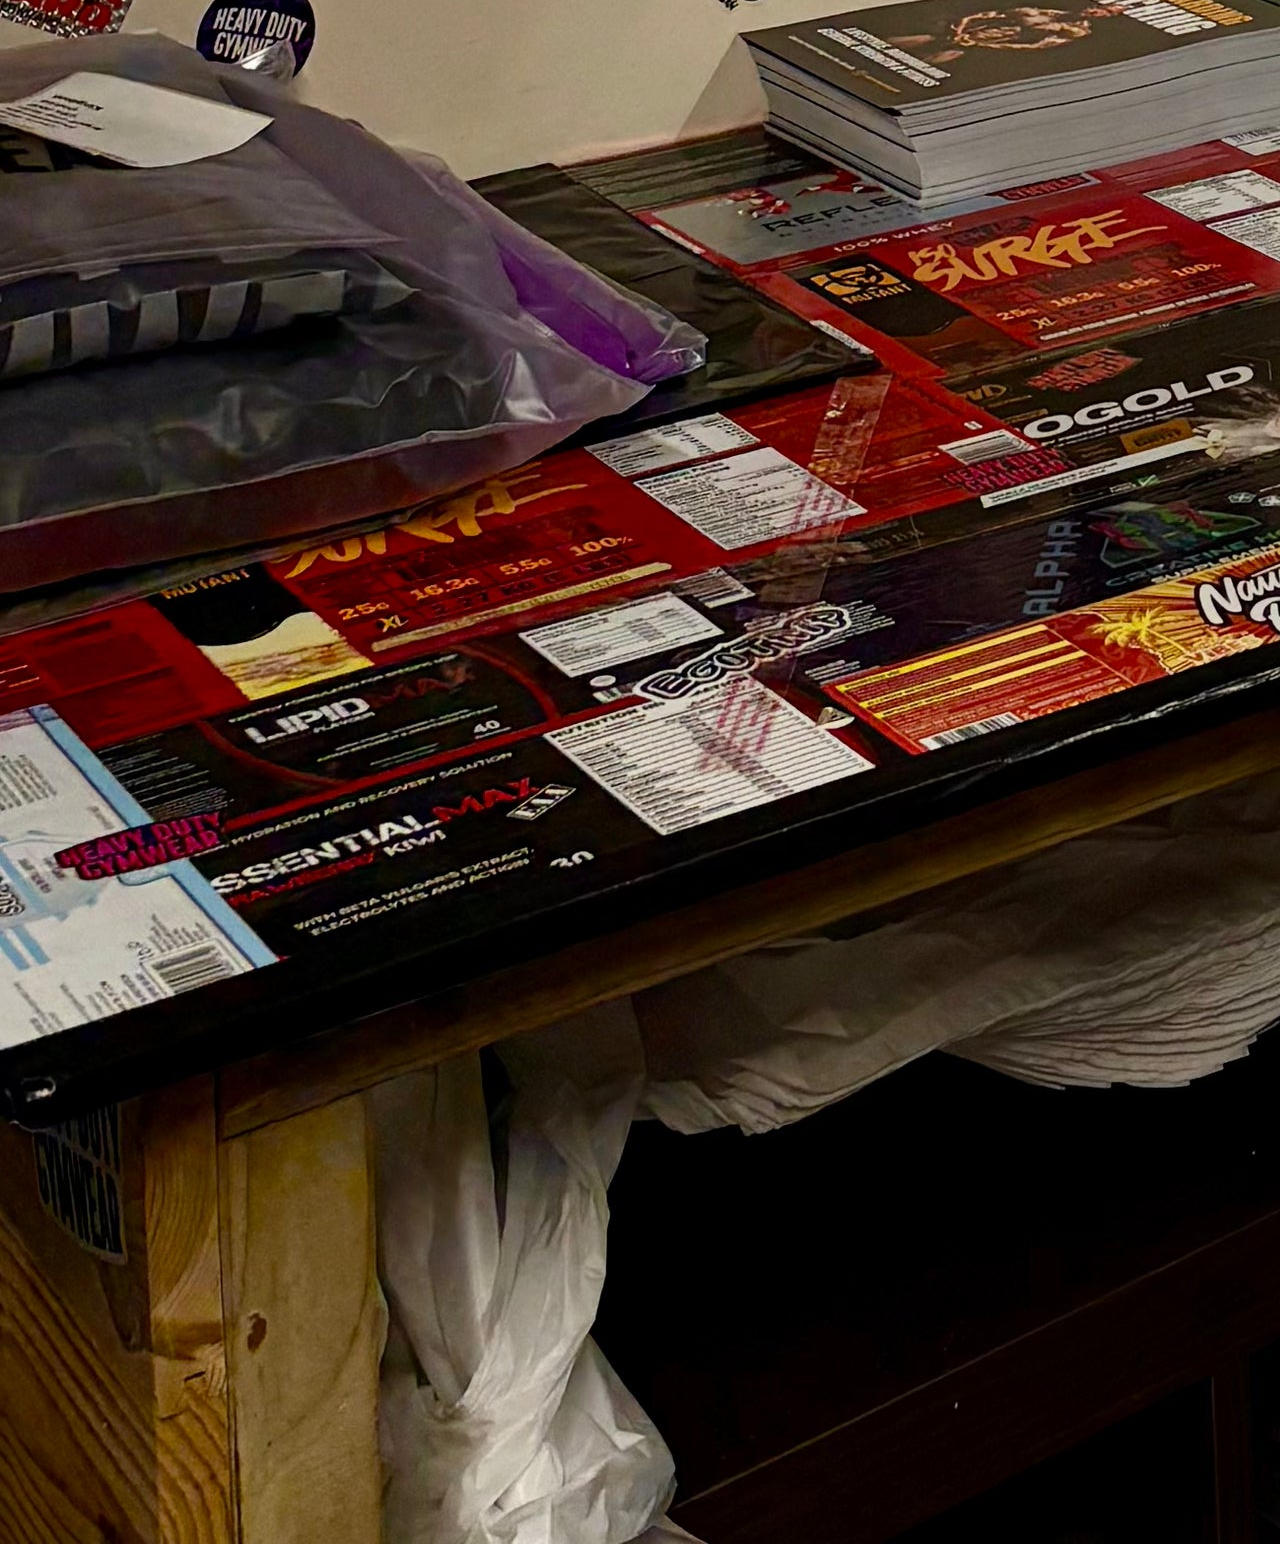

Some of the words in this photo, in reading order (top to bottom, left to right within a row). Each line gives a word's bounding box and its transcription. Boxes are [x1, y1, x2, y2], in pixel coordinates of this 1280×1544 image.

[212, 7, 267, 35] HEAVY
[264, 10, 308, 43] DUTY
[212, 31, 277, 61] GYMW
[761, 194, 904, 233] REFLE
[833, 236, 889, 254] 100%
[892, 219, 956, 241] WHEY
[841, 283, 914, 307] MUTANT
[1022, 365, 1256, 439] OGOLD
[160, 569, 252, 601] MUTANT
[379, 613, 410, 634] XL
[244, 696, 372, 745] LIPID
[356, 774, 437, 807] RECOVERY
[438, 751, 514, 780] SOLUTION
[55, 827, 144, 868] HEAVY
[150, 811, 221, 841] DUTY
[76, 829, 221, 881] GYMWEAR
[209, 813, 442, 895] SSENTIAL
[429, 776, 541, 824] MAX
[381, 828, 447, 858] KIWI
[307, 891, 431, 937] ELECTROLYTES
[339, 896, 382, 917] BETA
[381, 869, 462, 905] VULGARIS
